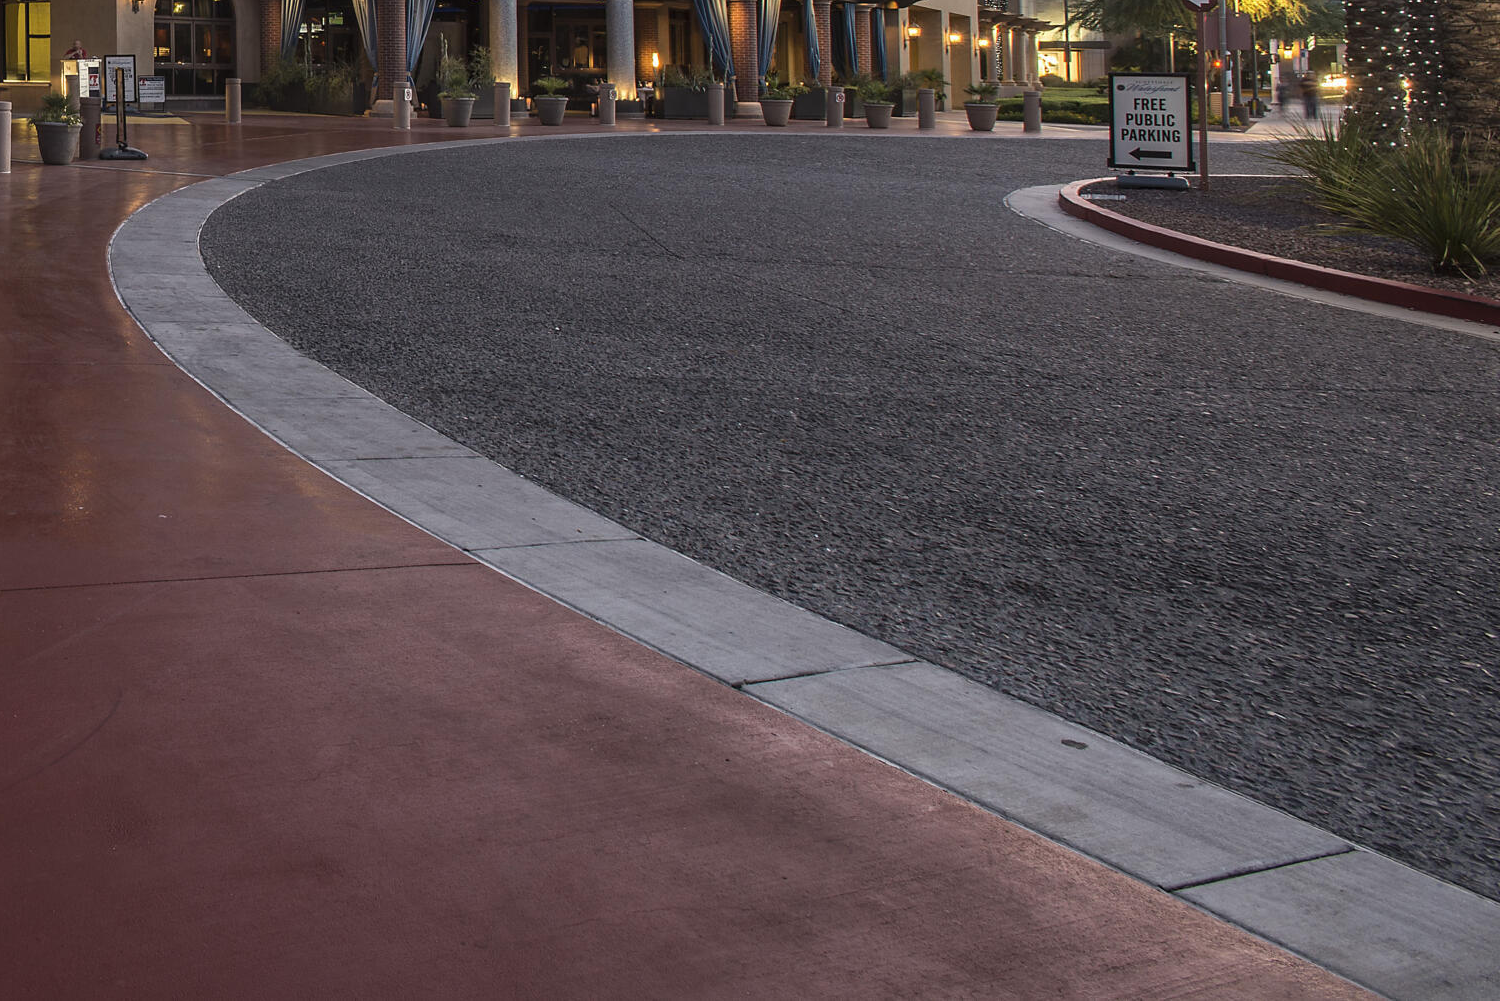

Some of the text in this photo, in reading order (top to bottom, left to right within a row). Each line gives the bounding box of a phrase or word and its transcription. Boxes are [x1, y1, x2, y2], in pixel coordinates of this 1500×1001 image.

[1133, 98, 1167, 111] FREE
[1125, 113, 1176, 127] PUBLIC
[1121, 128, 1181, 143] PARKING
